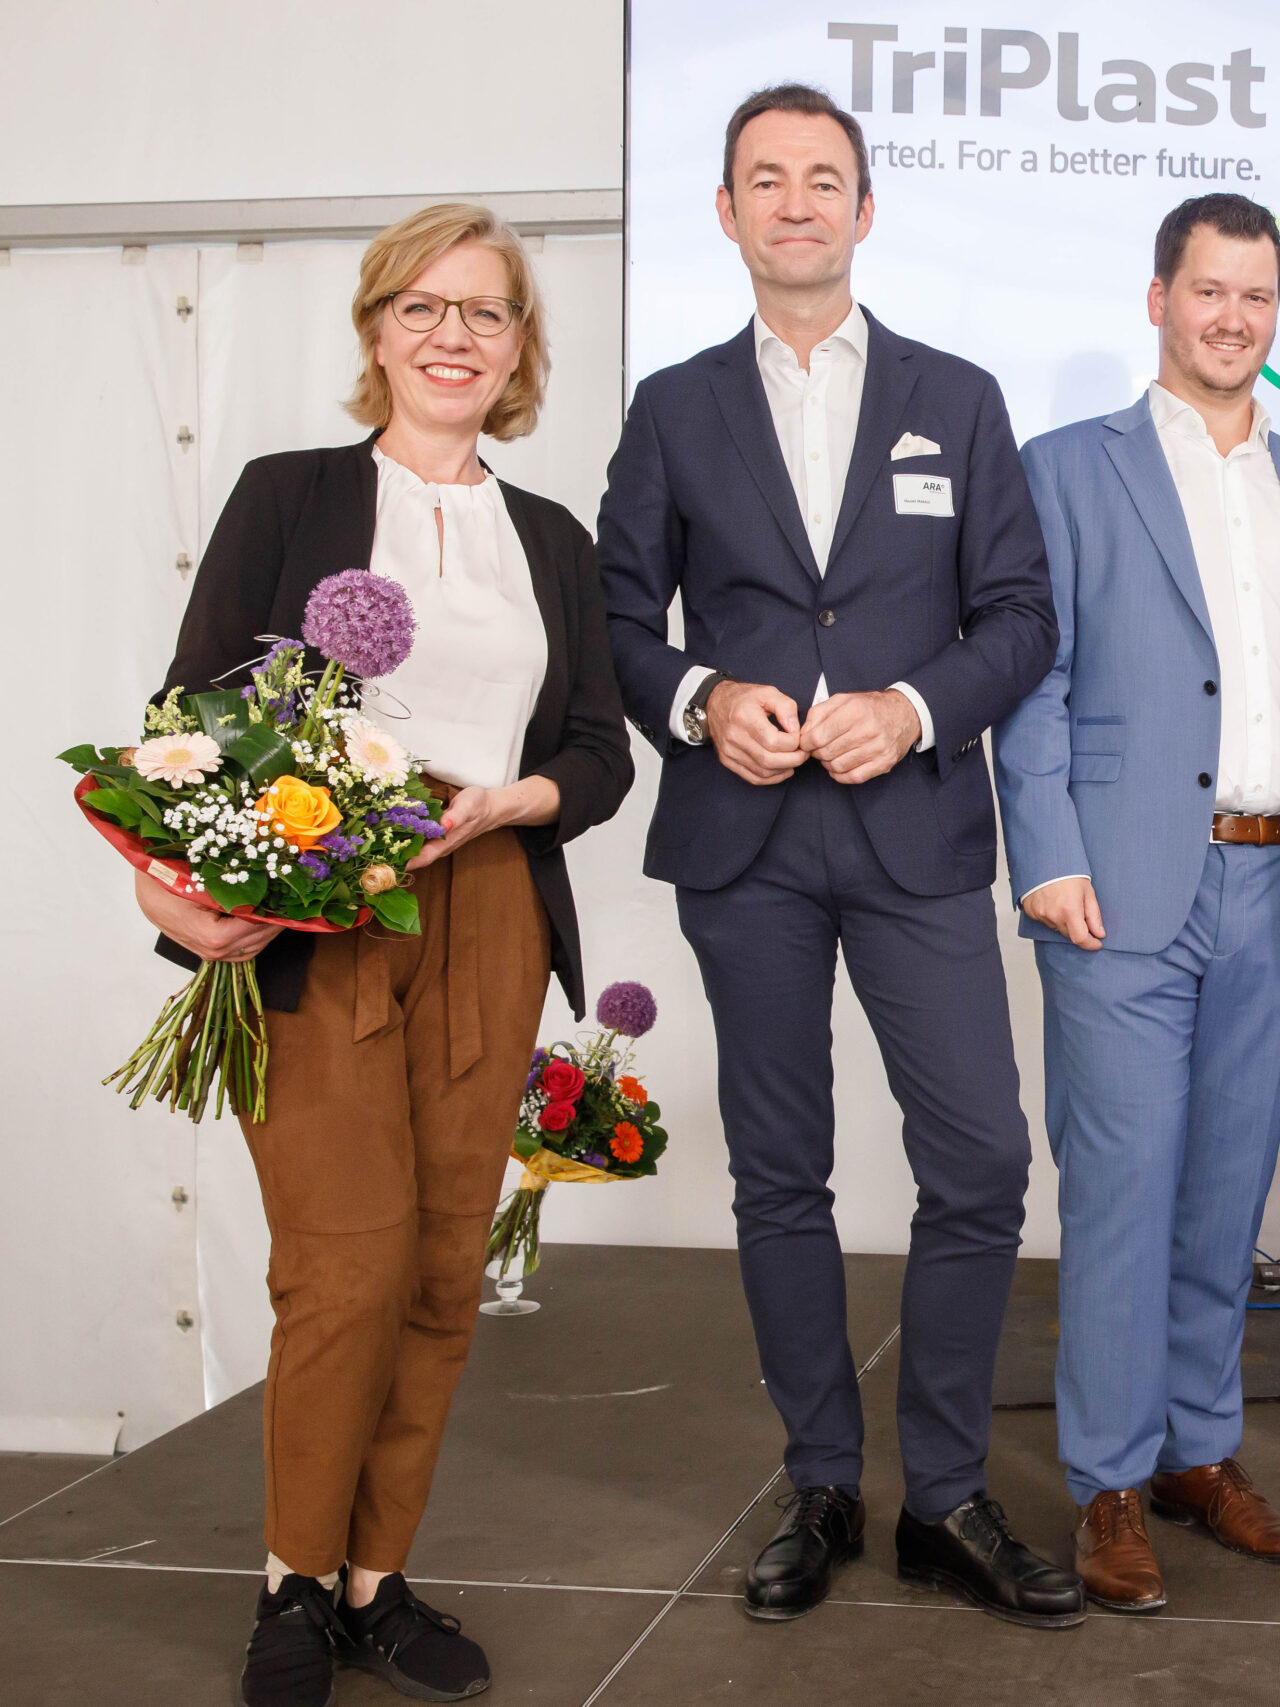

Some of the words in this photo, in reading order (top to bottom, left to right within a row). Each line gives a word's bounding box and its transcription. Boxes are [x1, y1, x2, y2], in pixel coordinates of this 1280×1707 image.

[828, 22, 1266, 128] TriPlast
[958, 140, 1010, 171] For
[1020, 149, 1038, 173] a
[1050, 144, 1147, 176] better
[1156, 148, 1262, 181] future.
[923, 481, 942, 492] ARA
